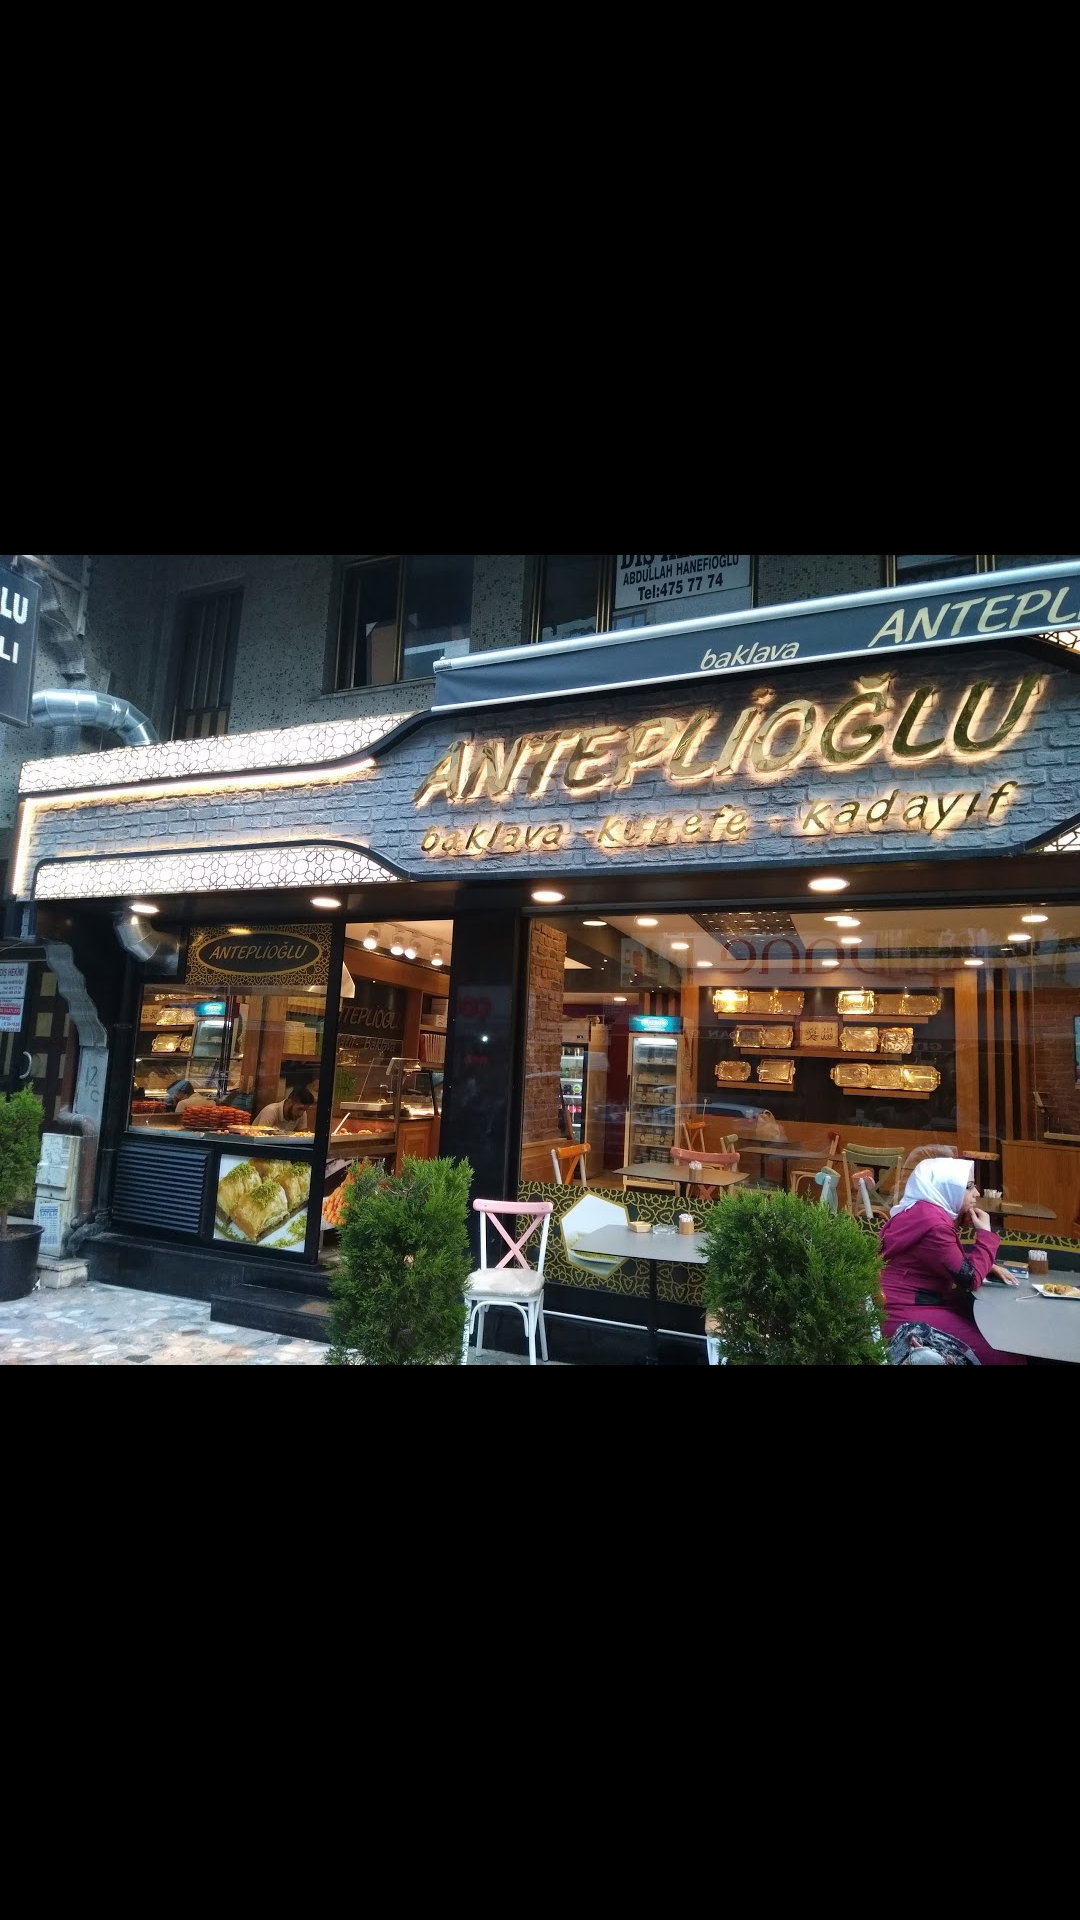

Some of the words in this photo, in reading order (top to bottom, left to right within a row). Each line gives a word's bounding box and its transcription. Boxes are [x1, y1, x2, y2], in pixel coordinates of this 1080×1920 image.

[623, 564, 673, 586] ABDULLAH
[688, 576, 703, 592] 77
[708, 572, 724, 588] 74
[700, 642, 800, 671] baklava
[868, 586, 1080, 648] ANTEPL
[413, 672, 1046, 807] ANTEPLİOĞLU
[420, 820, 565, 852] baklava
[802, 780, 1019, 836] kadayıf
[208, 940, 309, 960] ANTEPLİOĞLU
